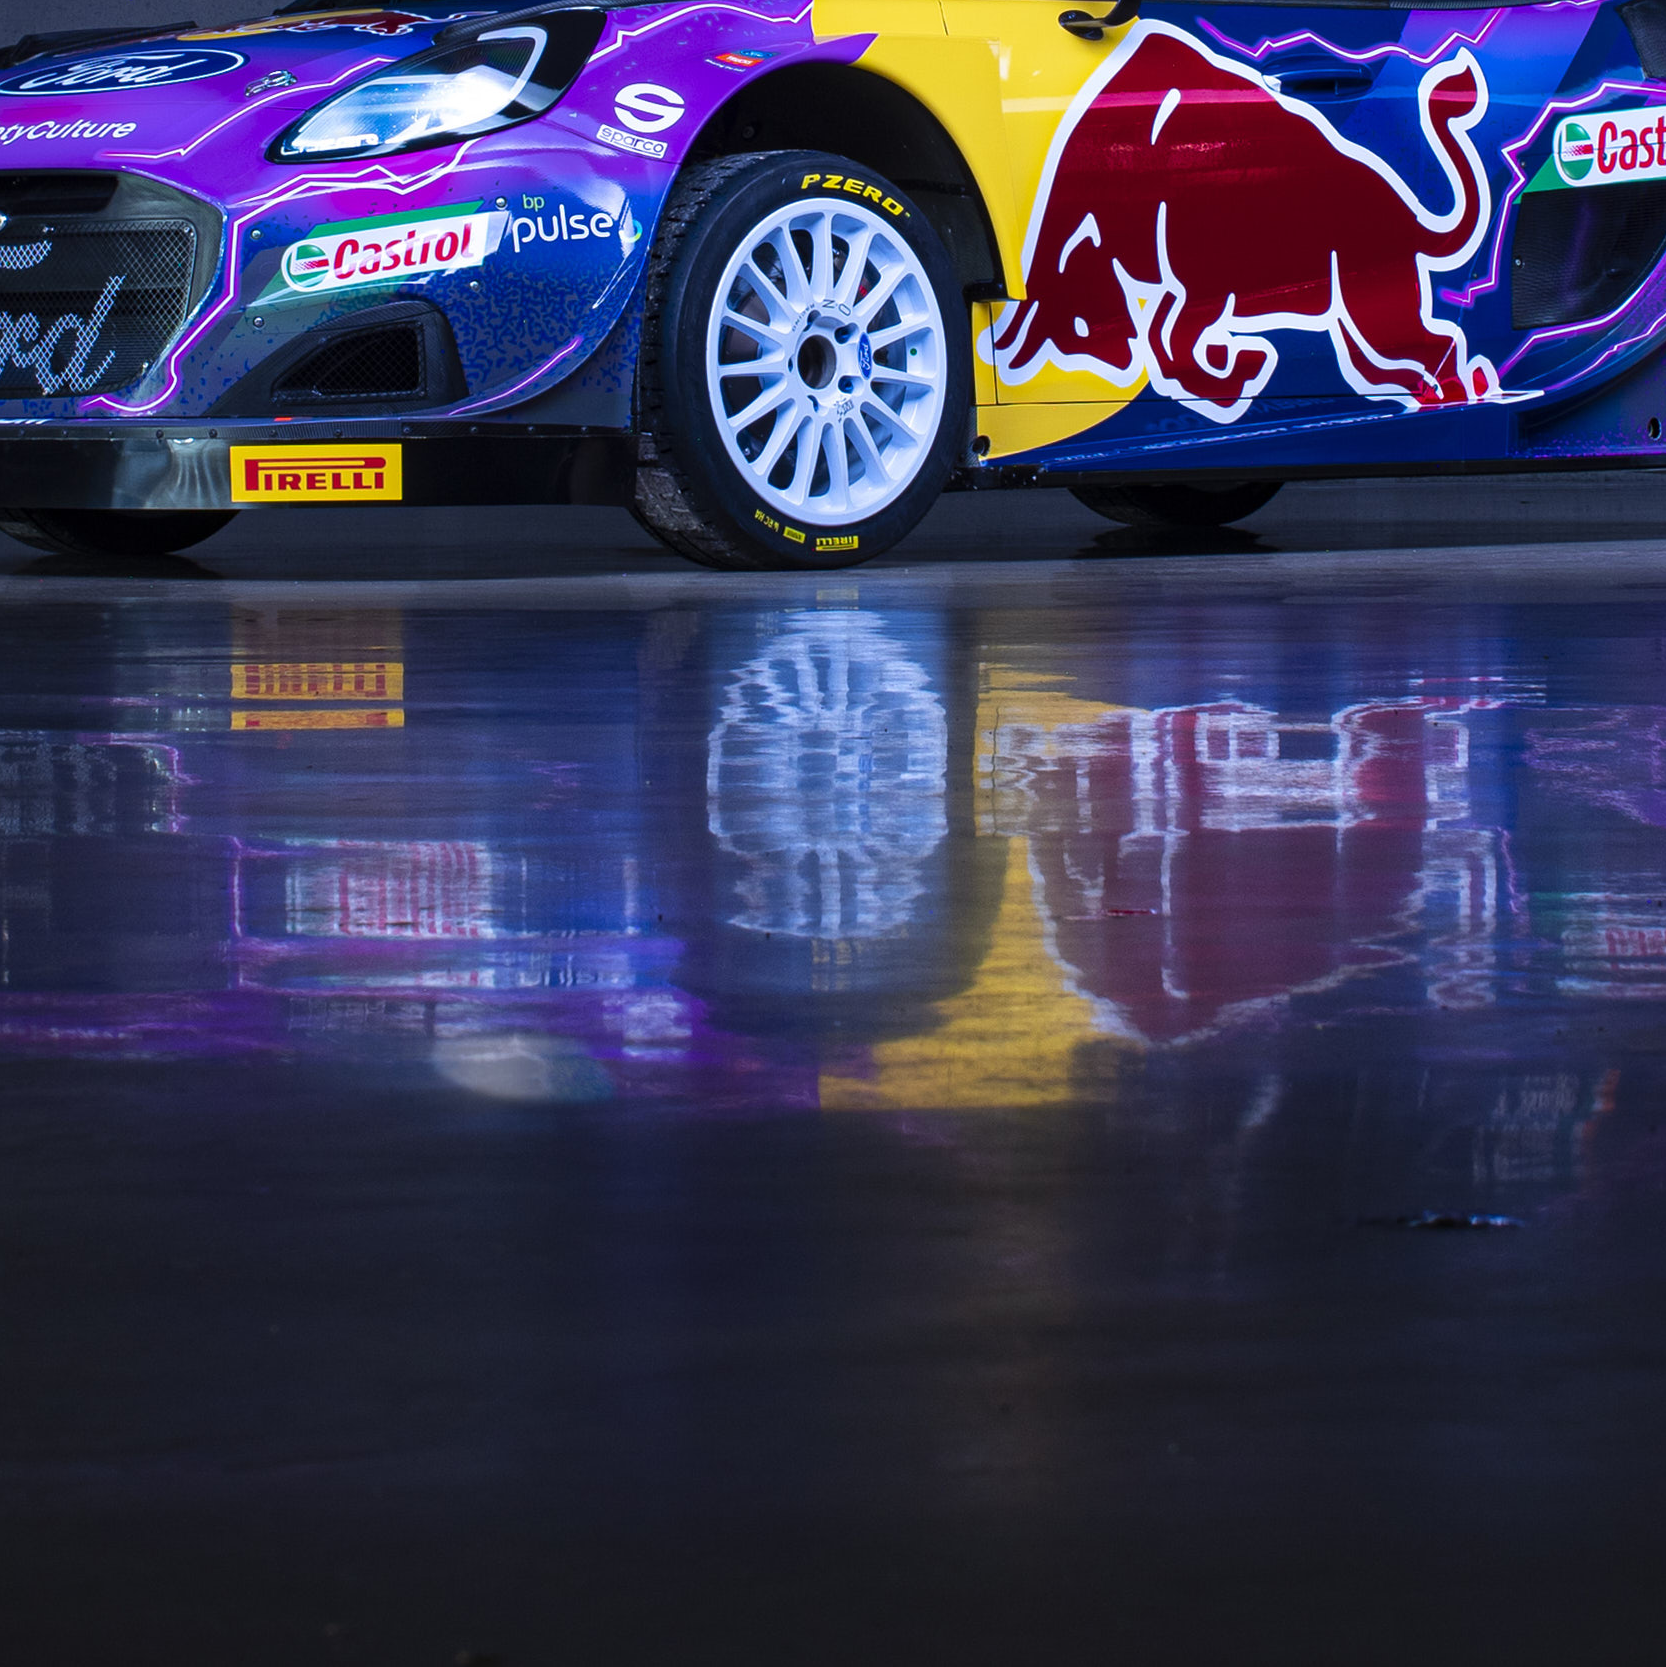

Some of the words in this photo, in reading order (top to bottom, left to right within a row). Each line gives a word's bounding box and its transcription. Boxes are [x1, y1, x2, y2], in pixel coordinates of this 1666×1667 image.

[19, 53, 208, 90] Ford
[600, 126, 665, 155] sparco
[523, 193, 545, 212] bp
[512, 206, 612, 253] pulse
[332, 221, 476, 282] Castrol
[244, 456, 387, 491] PIRELLI
[815, 535, 859, 552] PIRELLI
